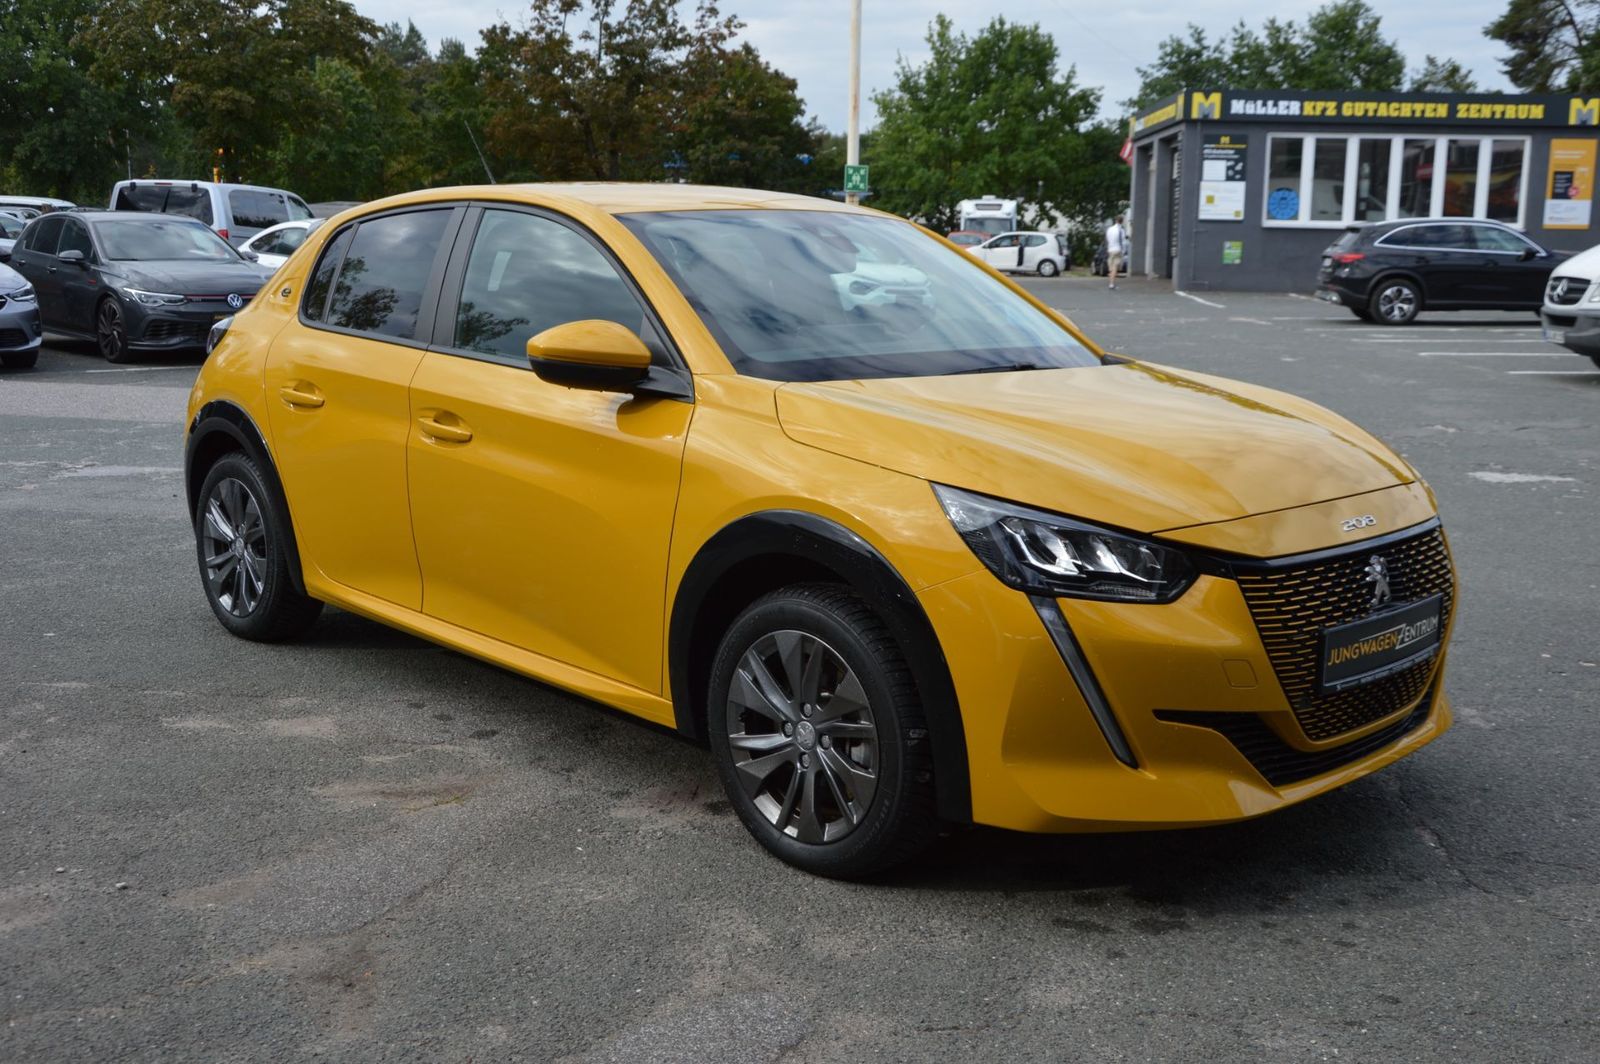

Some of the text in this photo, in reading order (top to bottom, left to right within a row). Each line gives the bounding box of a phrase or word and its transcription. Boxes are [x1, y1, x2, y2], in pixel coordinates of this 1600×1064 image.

[1191, 92, 1222, 119] M
[1302, 101, 1338, 116] KFZ
[1342, 102, 1449, 117] GUTACHTEN
[1456, 104, 1545, 119] ZENTRUM
[1343, 515, 1377, 531] 208
